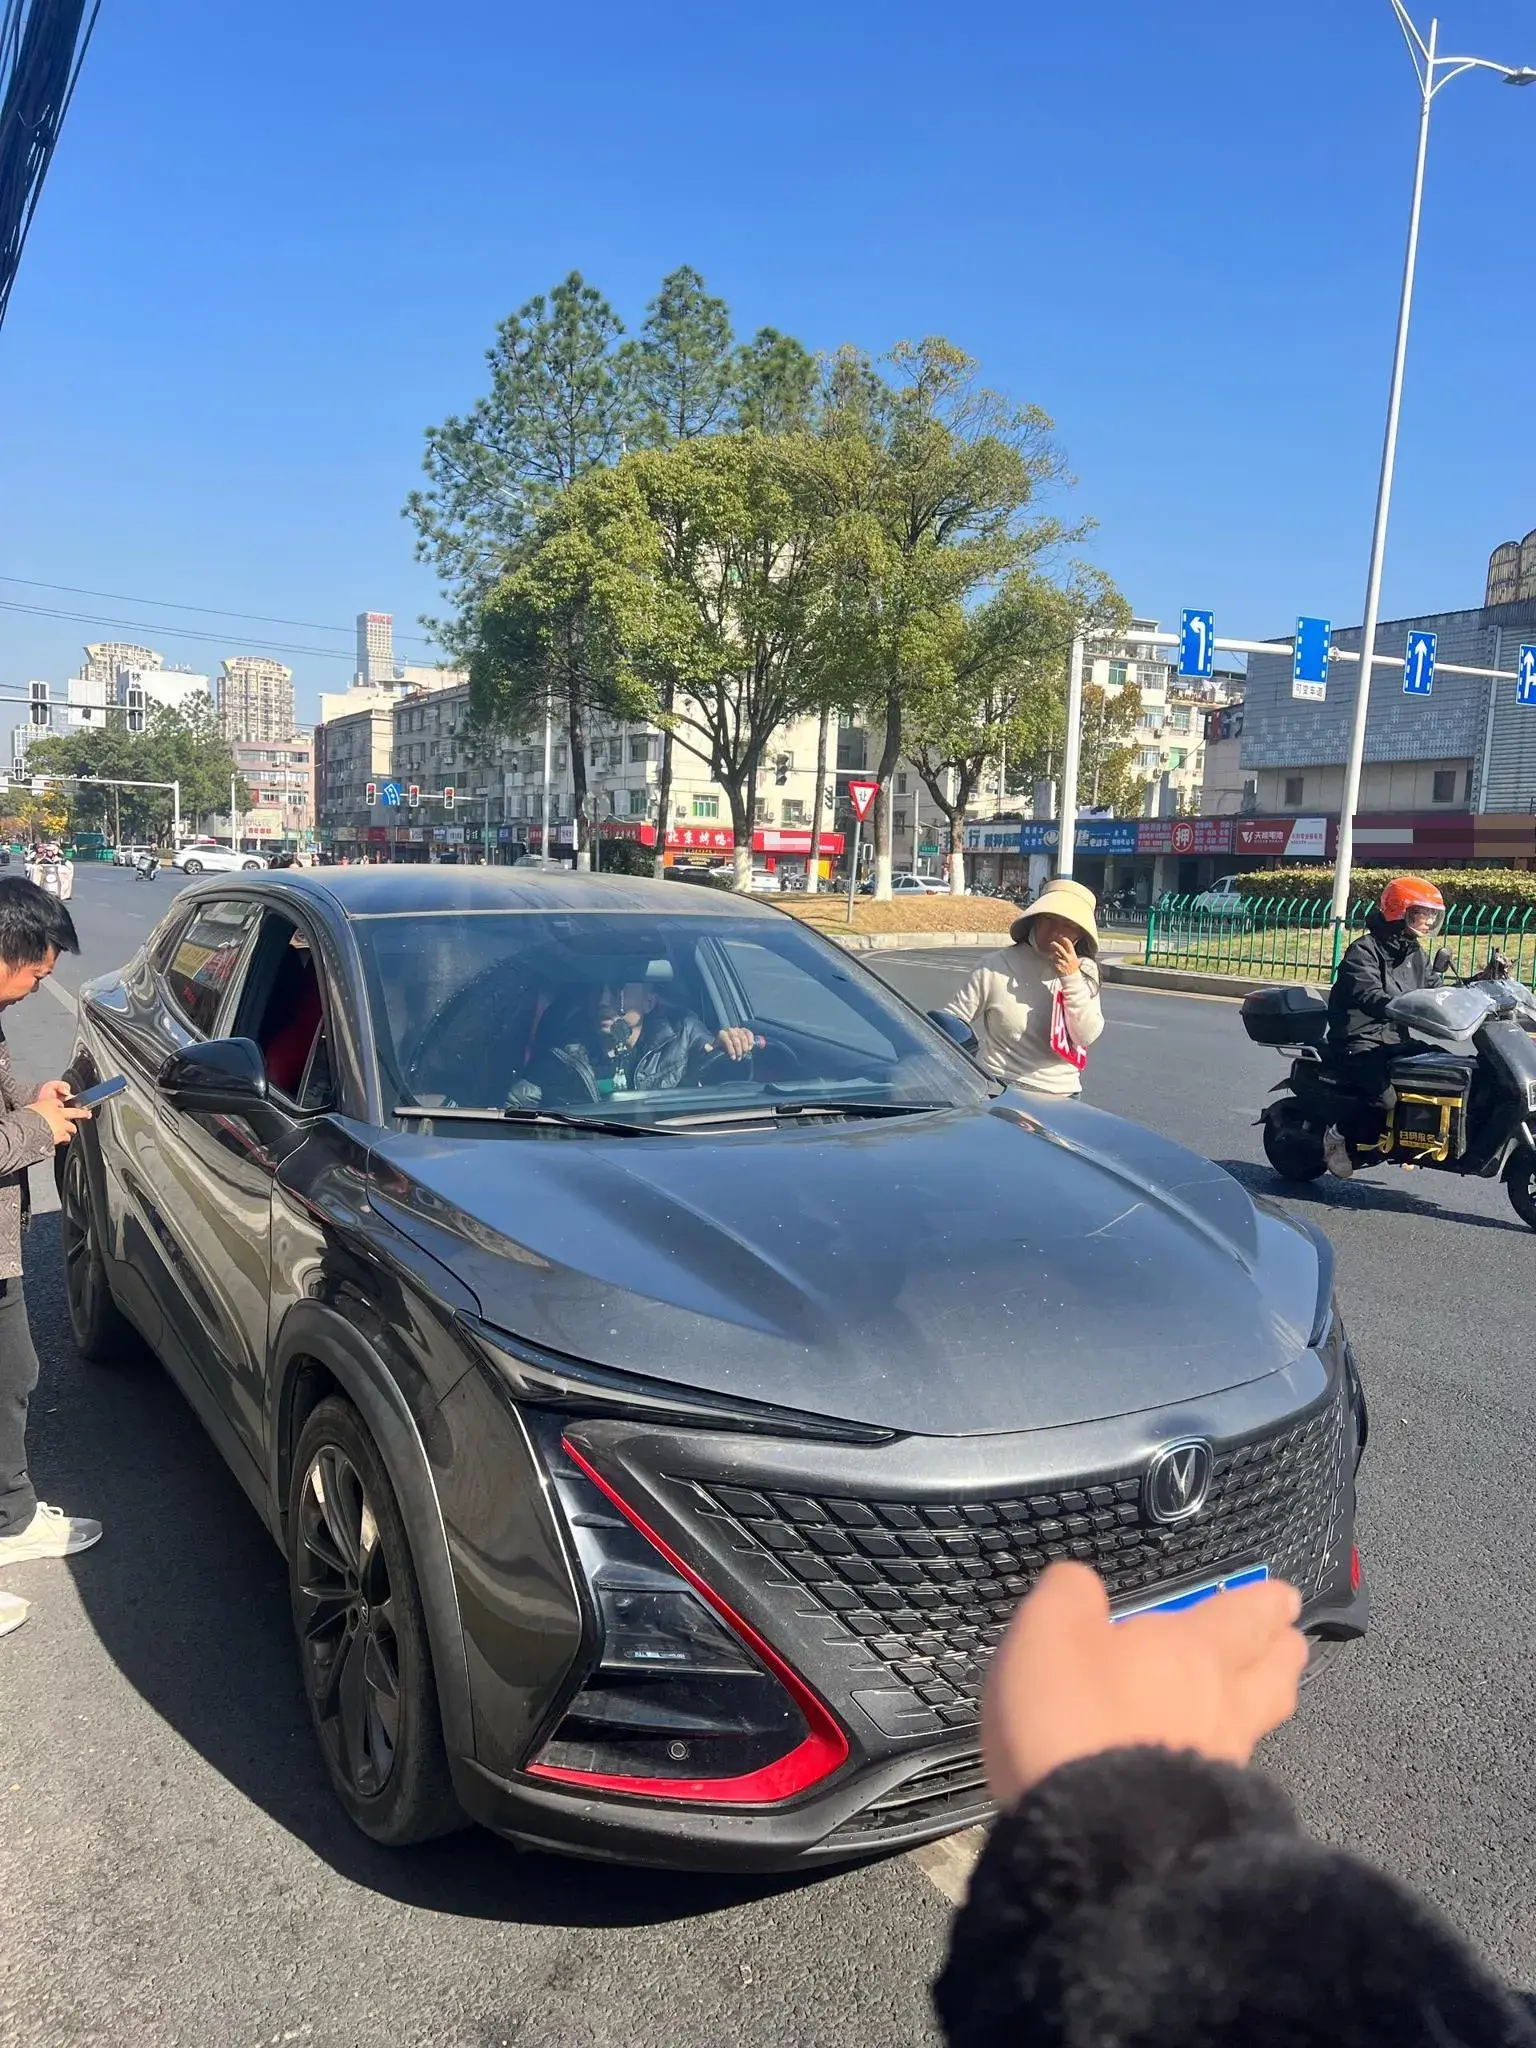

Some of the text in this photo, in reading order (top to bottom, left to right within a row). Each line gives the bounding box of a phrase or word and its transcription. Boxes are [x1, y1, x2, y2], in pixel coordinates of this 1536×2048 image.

[1295, 683, 1323, 697] 可变车道
[859, 790, 867, 802] 让
[667, 829, 726, 846] 北京烤鸭
[1175, 828, 1191, 847] 押
